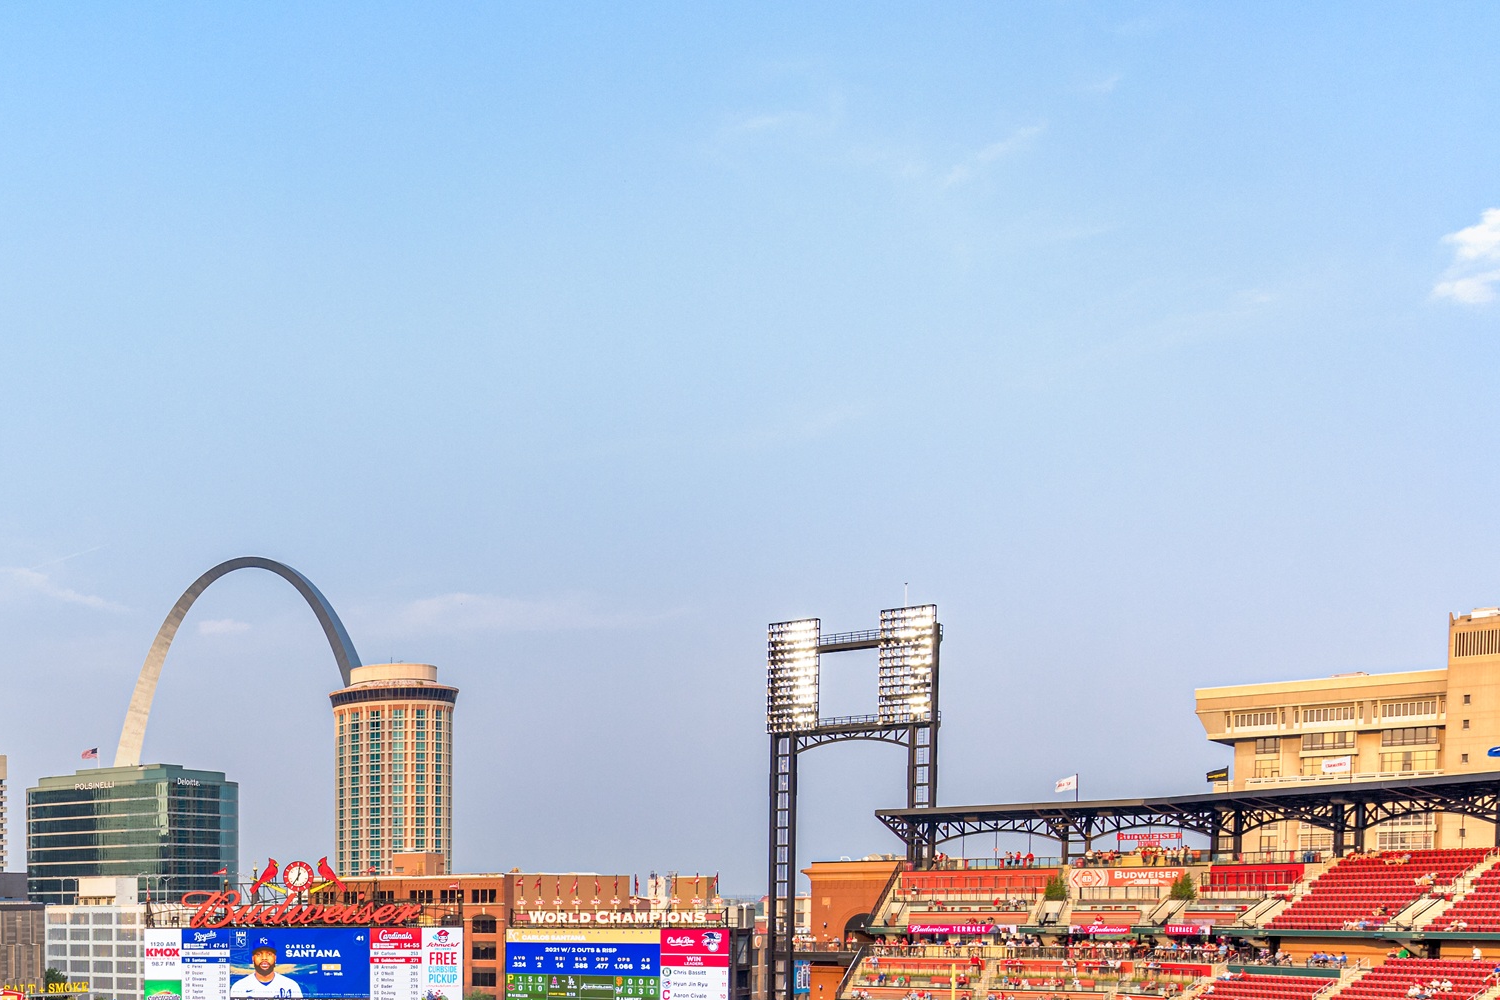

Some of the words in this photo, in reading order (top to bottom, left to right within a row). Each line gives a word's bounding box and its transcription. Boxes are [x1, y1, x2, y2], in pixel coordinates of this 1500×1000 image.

[74, 780, 115, 791] POLSINELLI
[1116, 832, 1182, 840] BUDWEISER
[1114, 870, 1179, 878] BUDWEISER
[181, 890, 422, 929] Budweiser
[528, 911, 591, 924] WORLD
[595, 910, 706, 924] CHAMPIONS
[910, 924, 950, 933] Budweiser
[1088, 925, 1128, 933] Budweiser
[194, 930, 217, 942] Royals
[378, 930, 412, 942] Cardinals
[146, 948, 180, 957] KMOX
[285, 949, 341, 958] SANTANA
[429, 952, 458, 966] FREE
[428, 974, 458, 984] PICKUP
[4, 984, 36, 994] SALT
[48, 982, 89, 994] SMOKE
